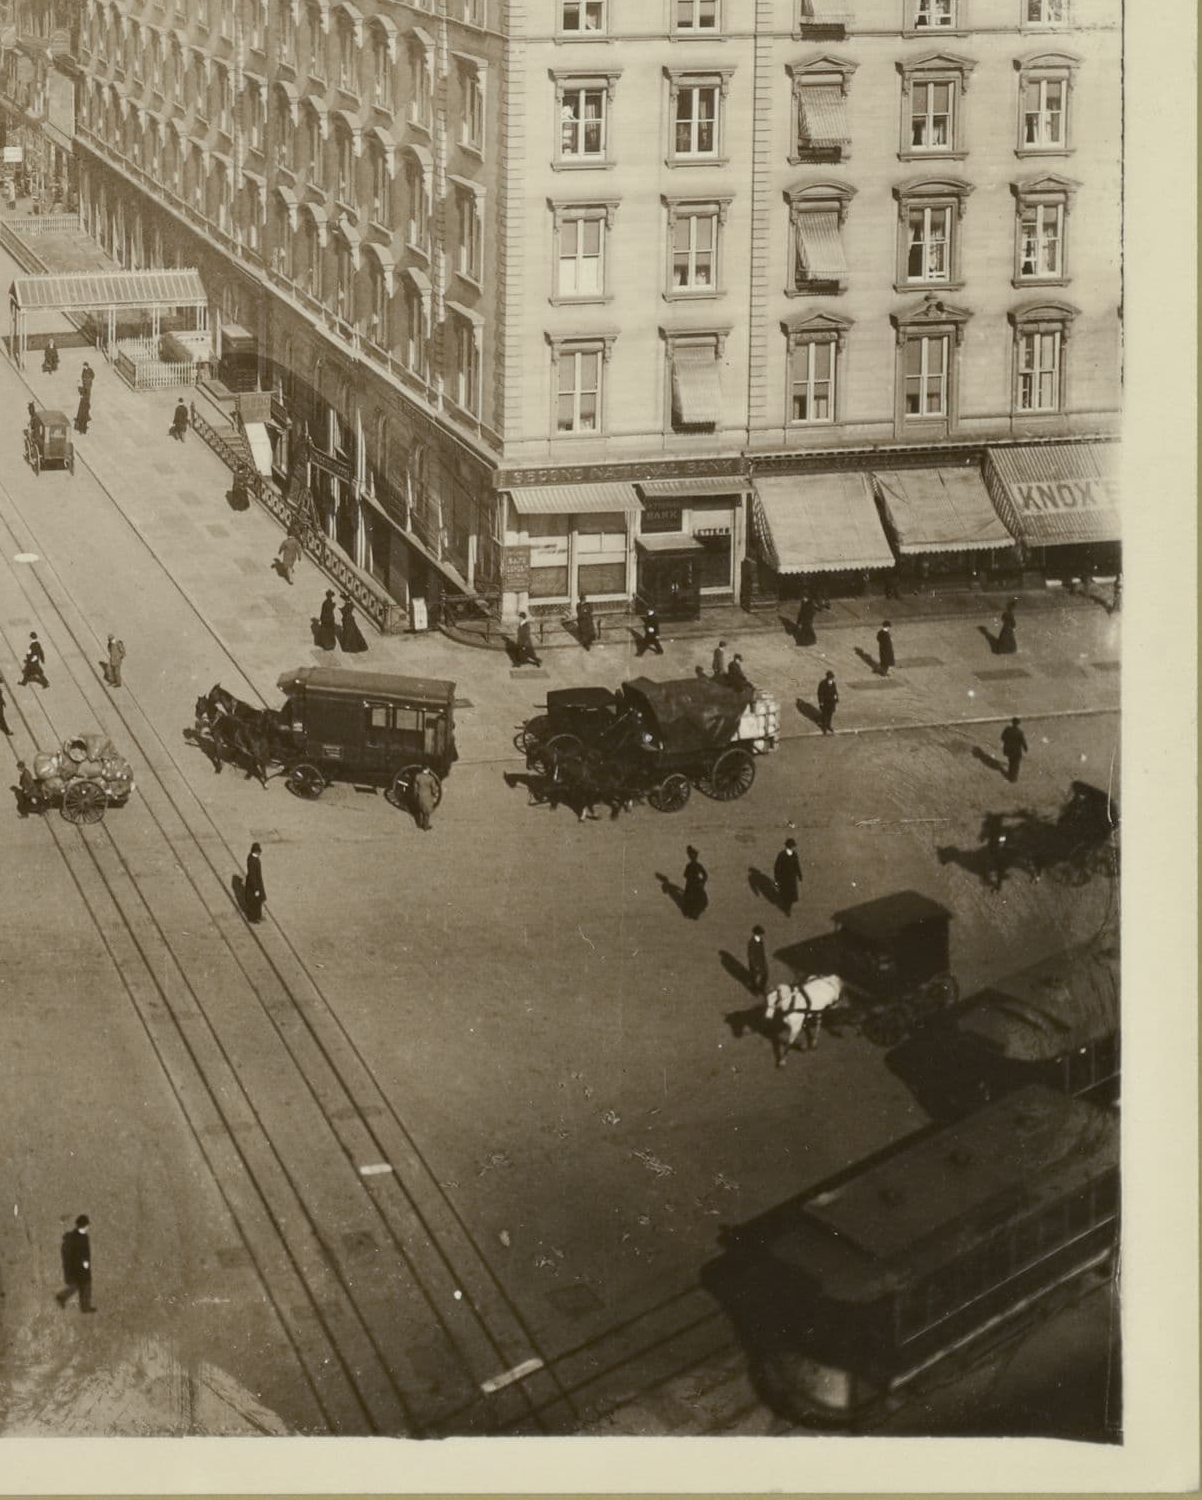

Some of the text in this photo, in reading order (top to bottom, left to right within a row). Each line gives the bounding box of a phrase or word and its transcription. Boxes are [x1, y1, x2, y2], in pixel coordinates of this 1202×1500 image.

[513, 460, 733, 484] SECOND NATIONAL BANK
